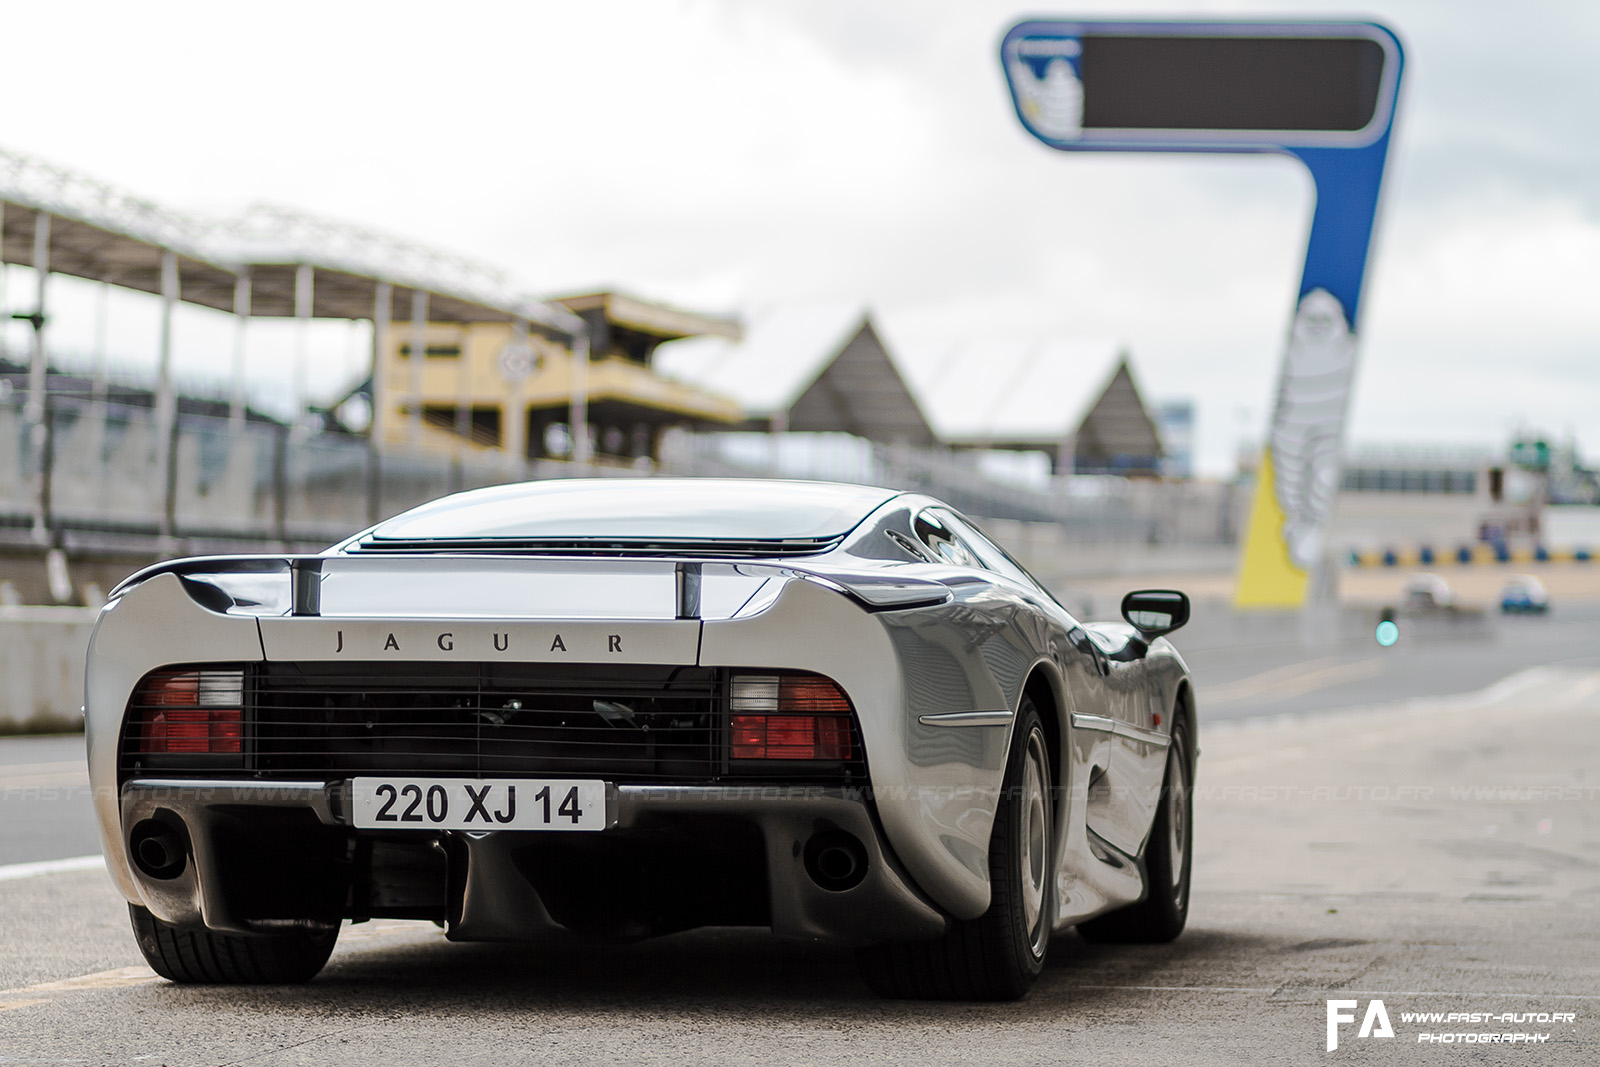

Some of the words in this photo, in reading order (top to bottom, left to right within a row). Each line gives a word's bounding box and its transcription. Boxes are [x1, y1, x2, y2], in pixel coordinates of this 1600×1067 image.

[336, 631, 622, 652] JAGUAR
[374, 784, 448, 822] 220
[463, 785, 516, 823] XJ
[534, 786, 583, 824] 14
